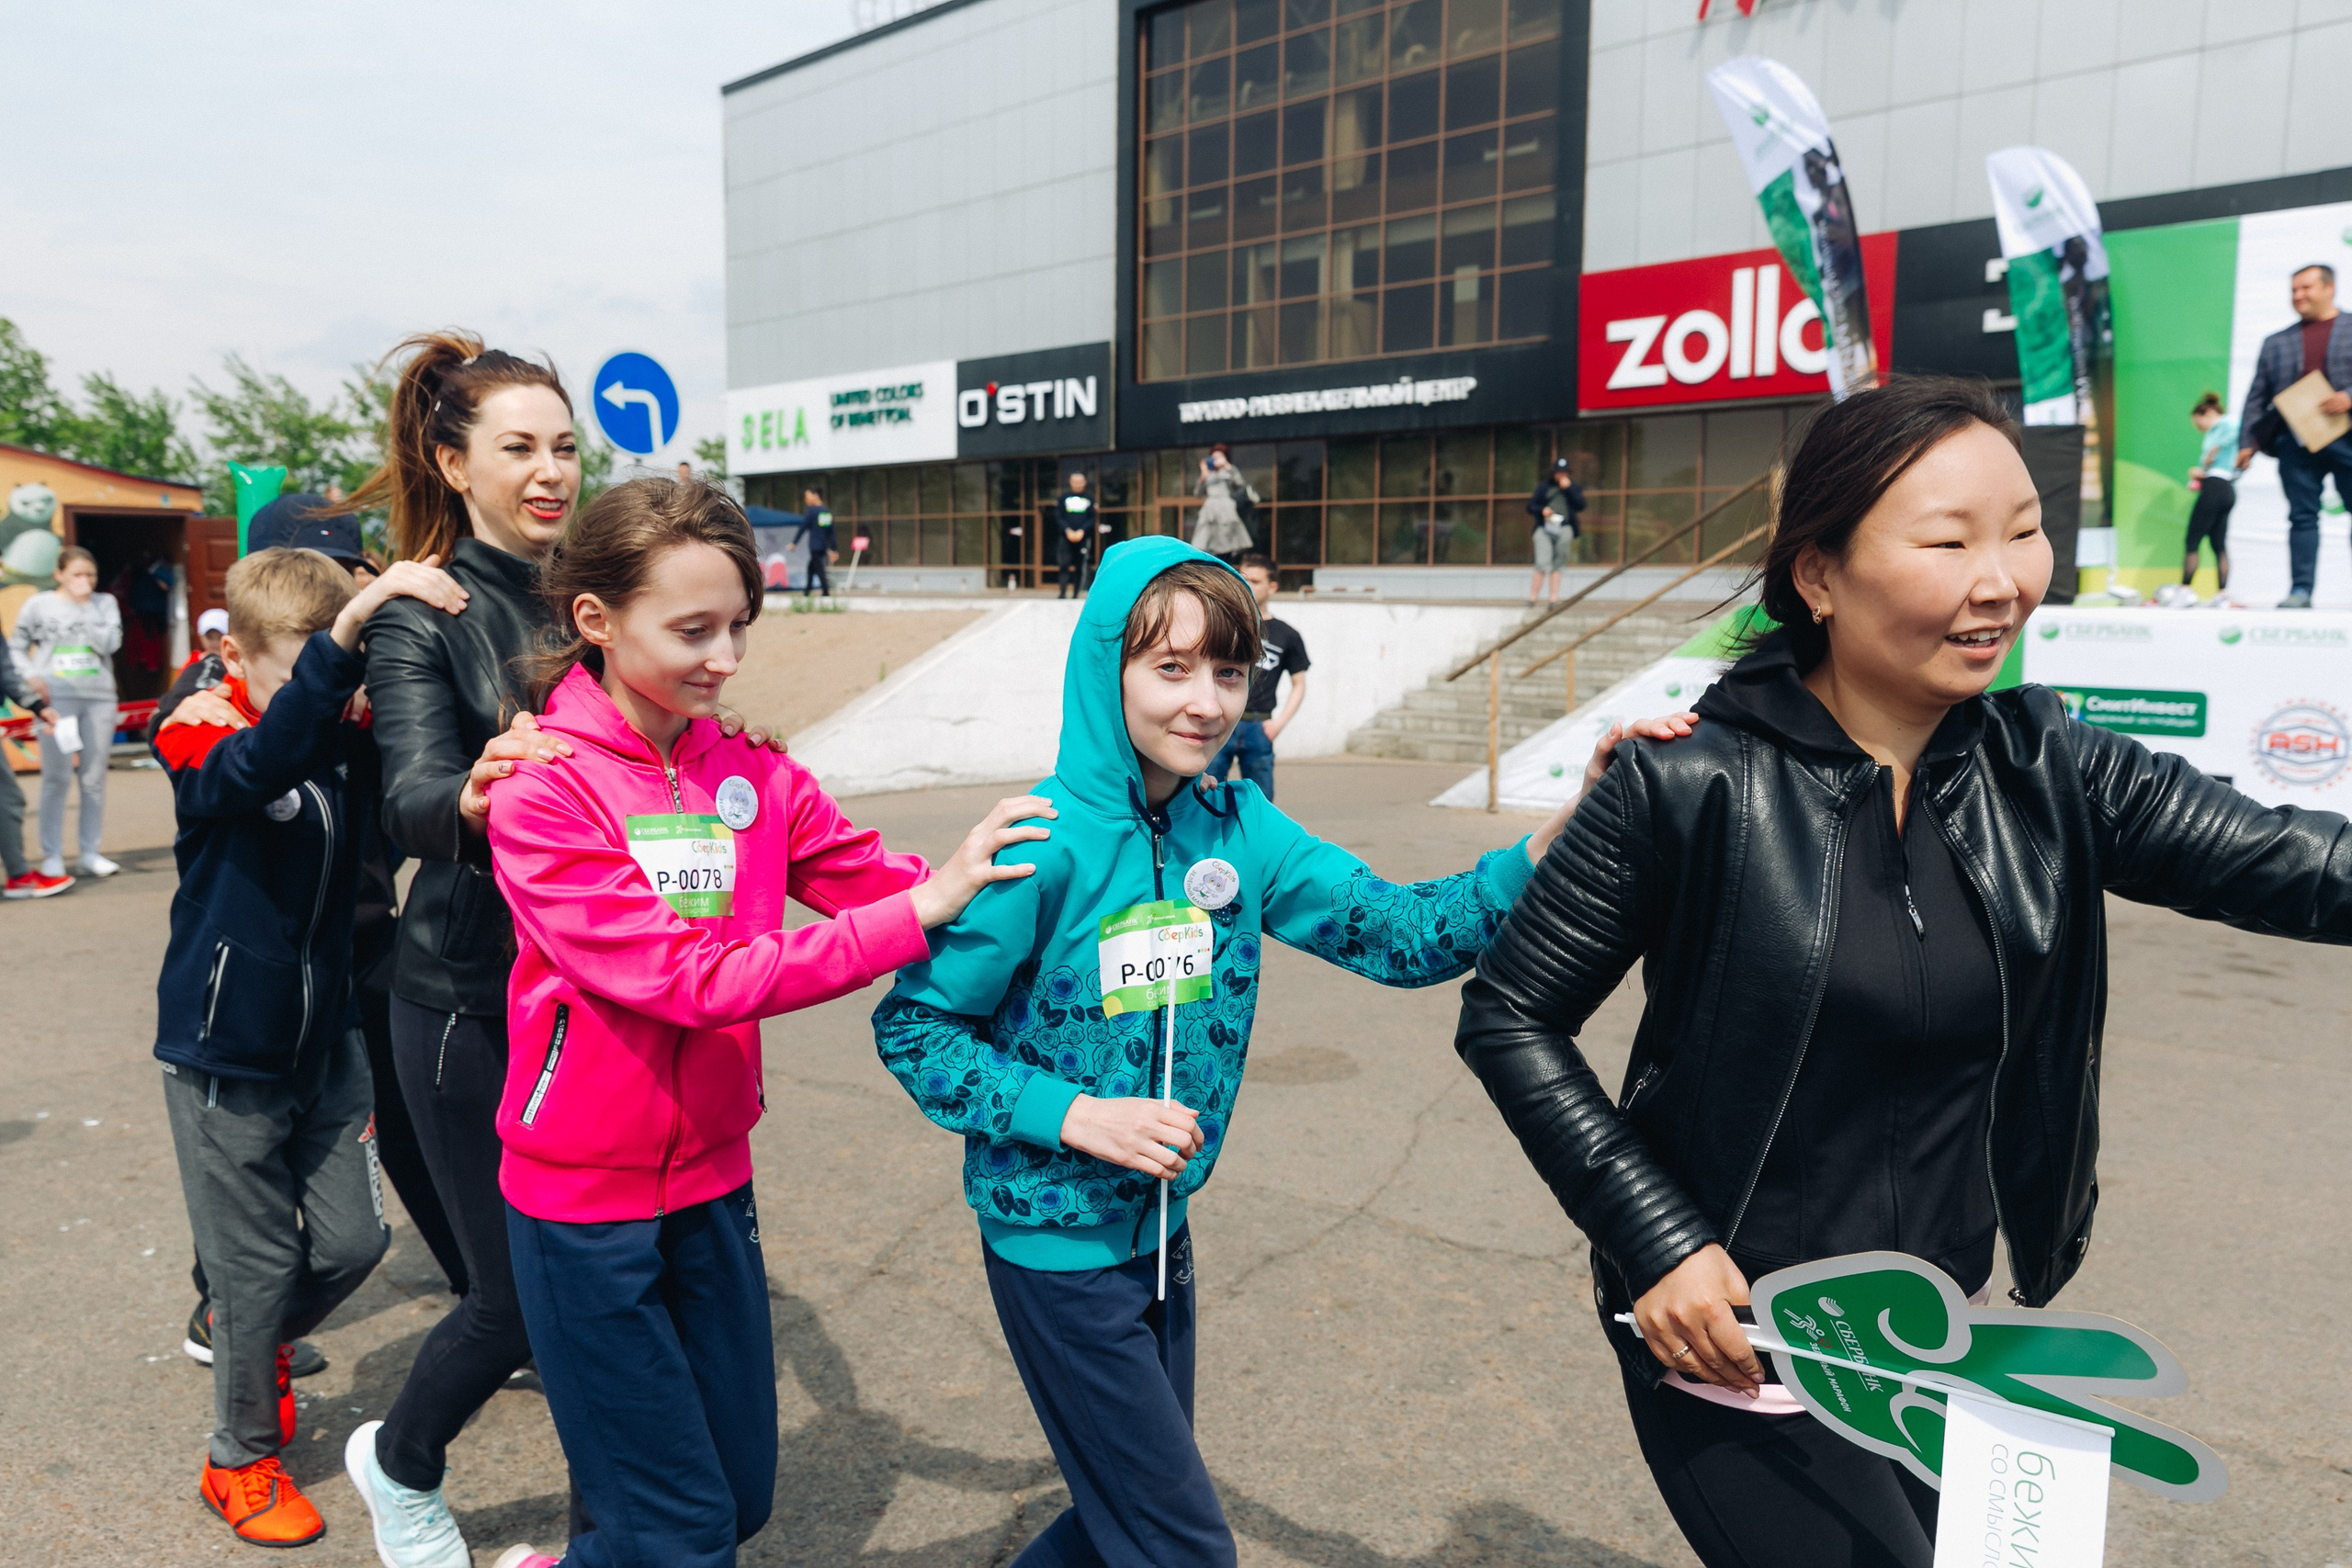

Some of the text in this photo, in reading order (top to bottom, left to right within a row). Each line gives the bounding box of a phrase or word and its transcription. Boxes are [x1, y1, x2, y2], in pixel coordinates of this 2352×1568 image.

[958, 375, 1097, 428] O'STIN
[741, 407, 809, 449] SELA
[692, 840, 728, 856] СберKids
[657, 868, 723, 893] P-0078
[1158, 925, 1204, 943] СберKids
[1836, 1321, 1883, 1393] СБЕРБНК
[1809, 1341, 1851, 1413] ЗЕНЫЙ МАРАФОН
[1991, 1444, 2009, 1474] со
